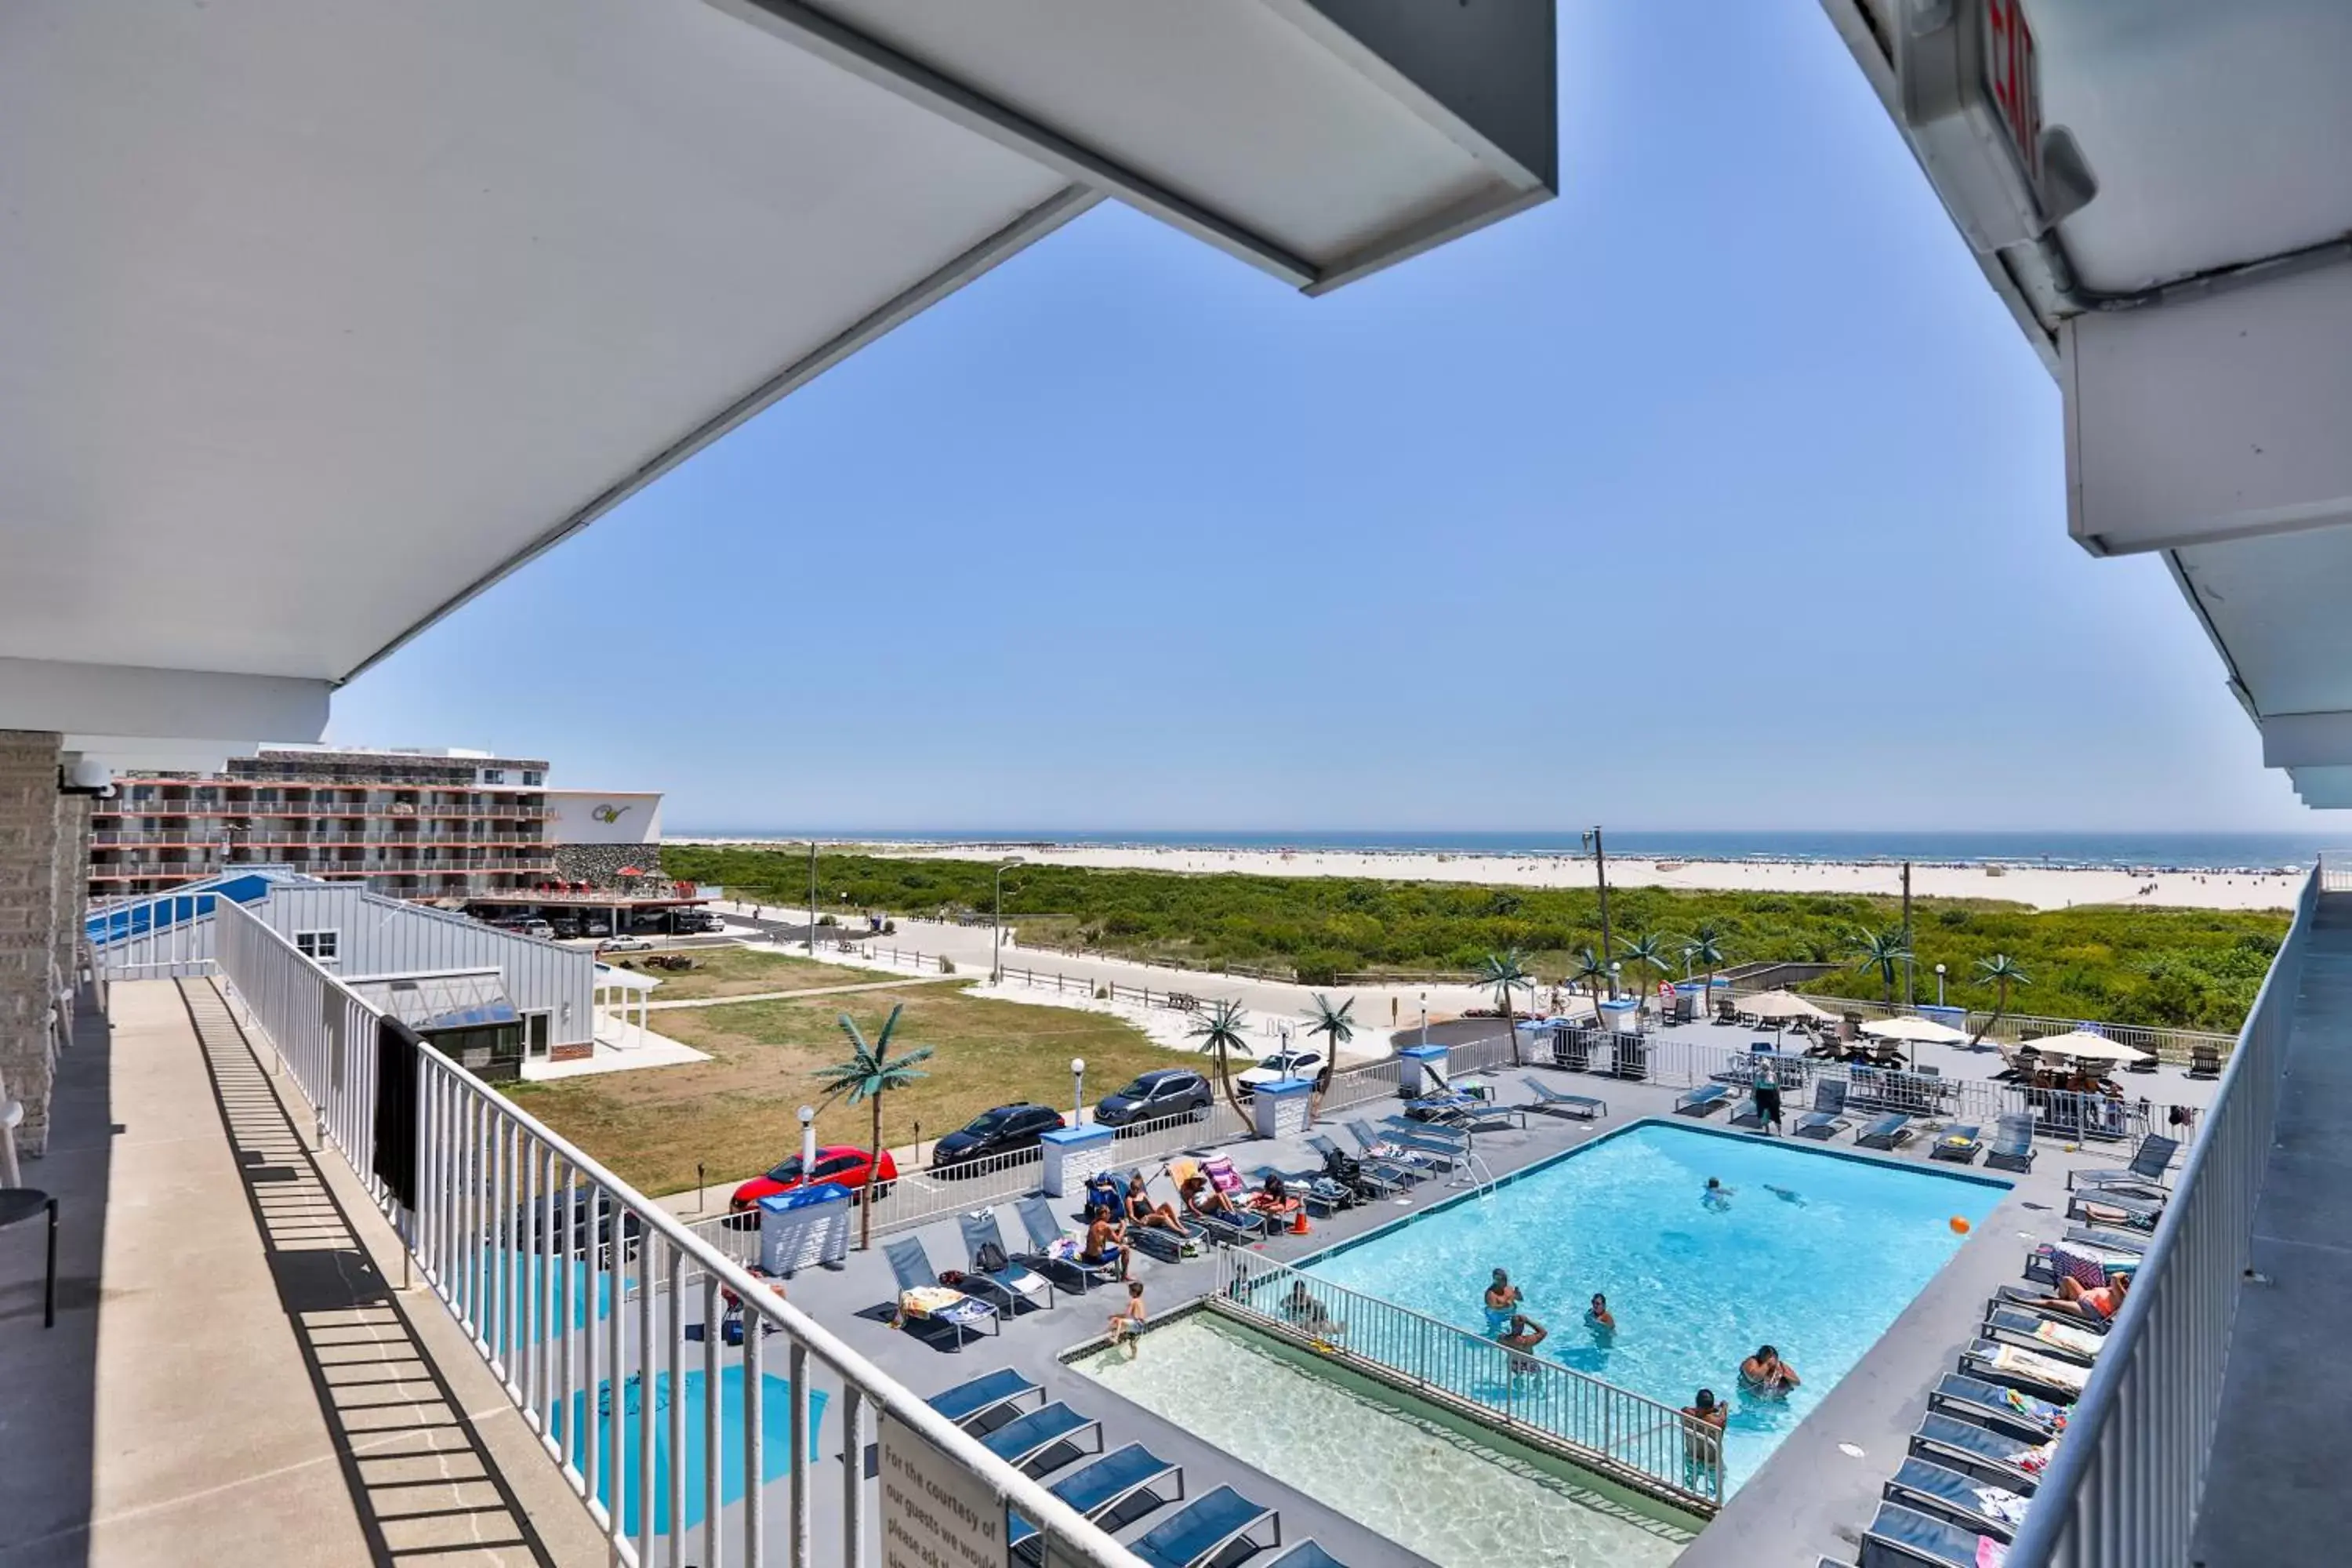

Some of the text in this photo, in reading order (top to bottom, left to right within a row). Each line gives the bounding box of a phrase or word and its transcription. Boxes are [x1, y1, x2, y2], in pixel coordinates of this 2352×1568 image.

[885, 1443, 996, 1541] For the courtesy of
[886, 1483, 904, 1505] our
[905, 1497, 939, 1536] guests
[941, 1526, 958, 1552] we
[887, 1517, 920, 1554] please
[921, 1544, 939, 1568] ask
